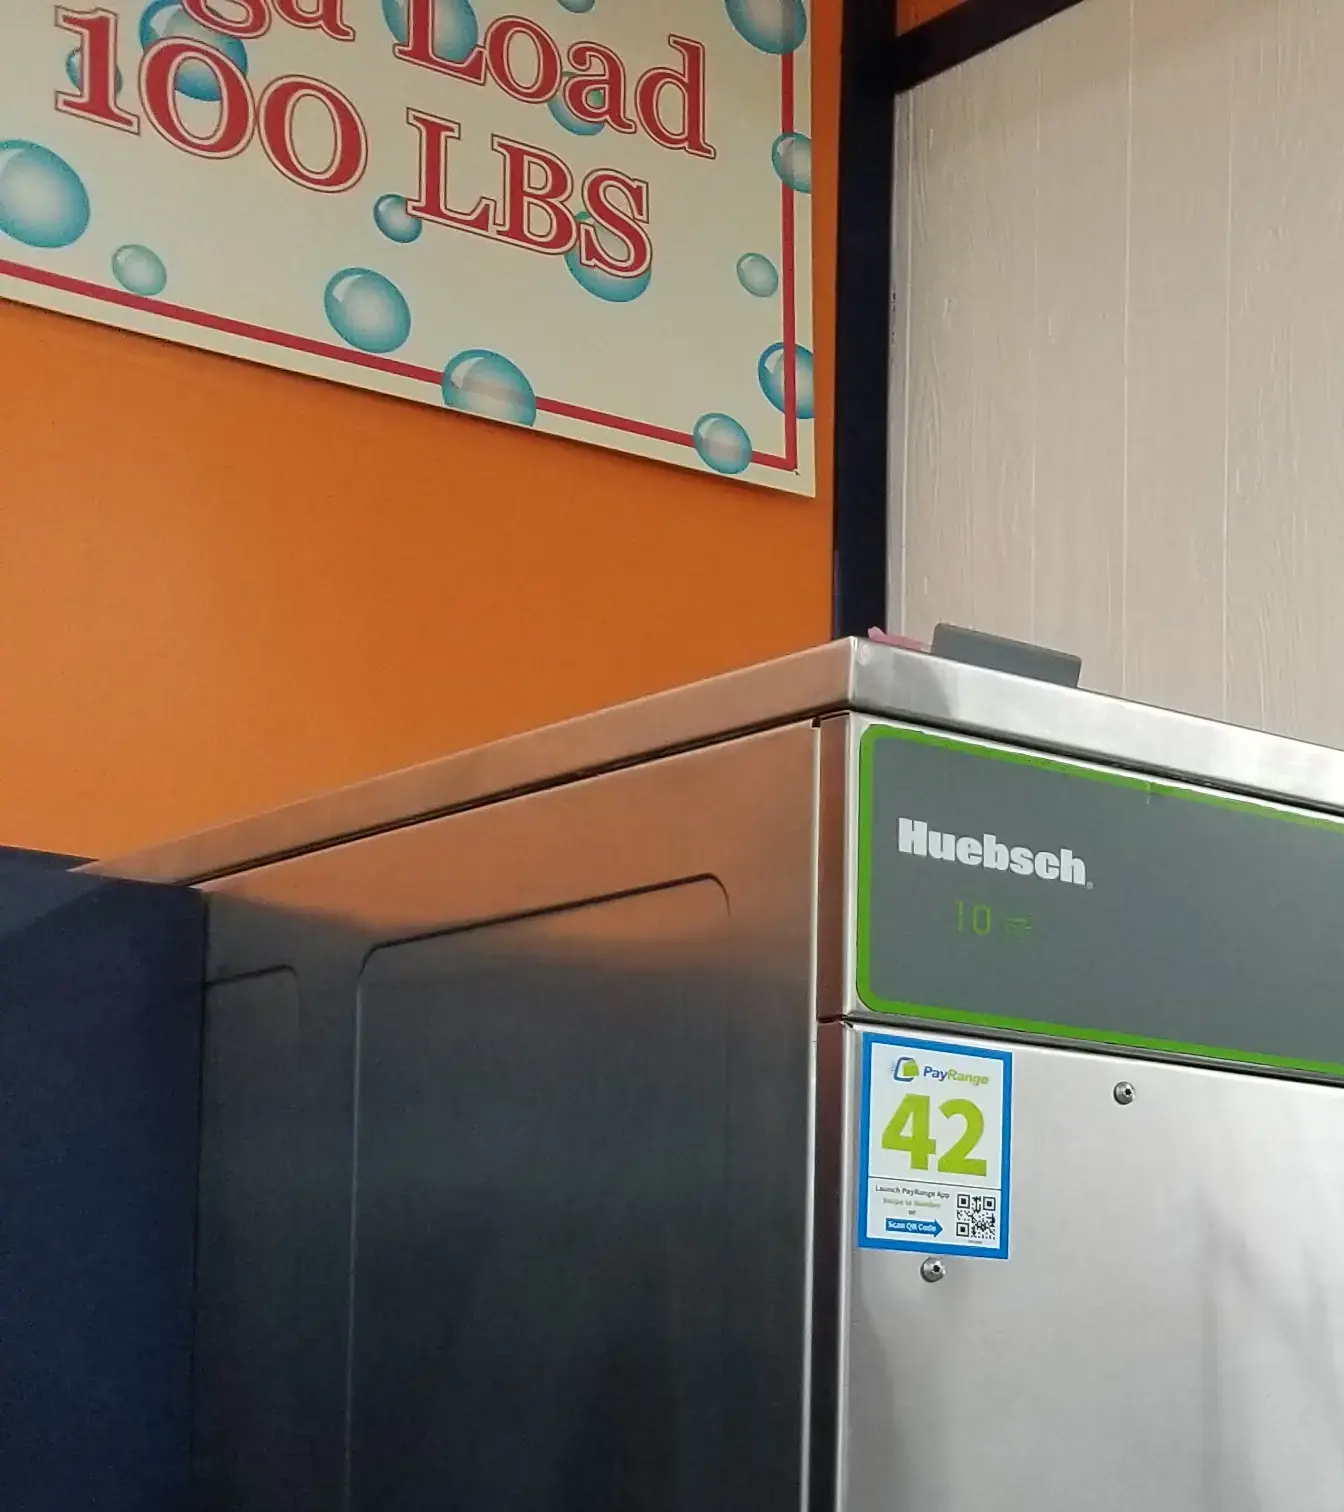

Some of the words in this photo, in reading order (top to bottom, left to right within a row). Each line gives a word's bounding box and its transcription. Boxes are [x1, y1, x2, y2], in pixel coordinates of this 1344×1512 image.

[394, 0, 716, 159] Load
[54, 6, 369, 194] 100
[405, 107, 653, 279] LBS
[898, 817, 1087, 886] Huebsch
[922, 1065, 989, 1087] PayRange
[881, 1092, 988, 1177] 42
